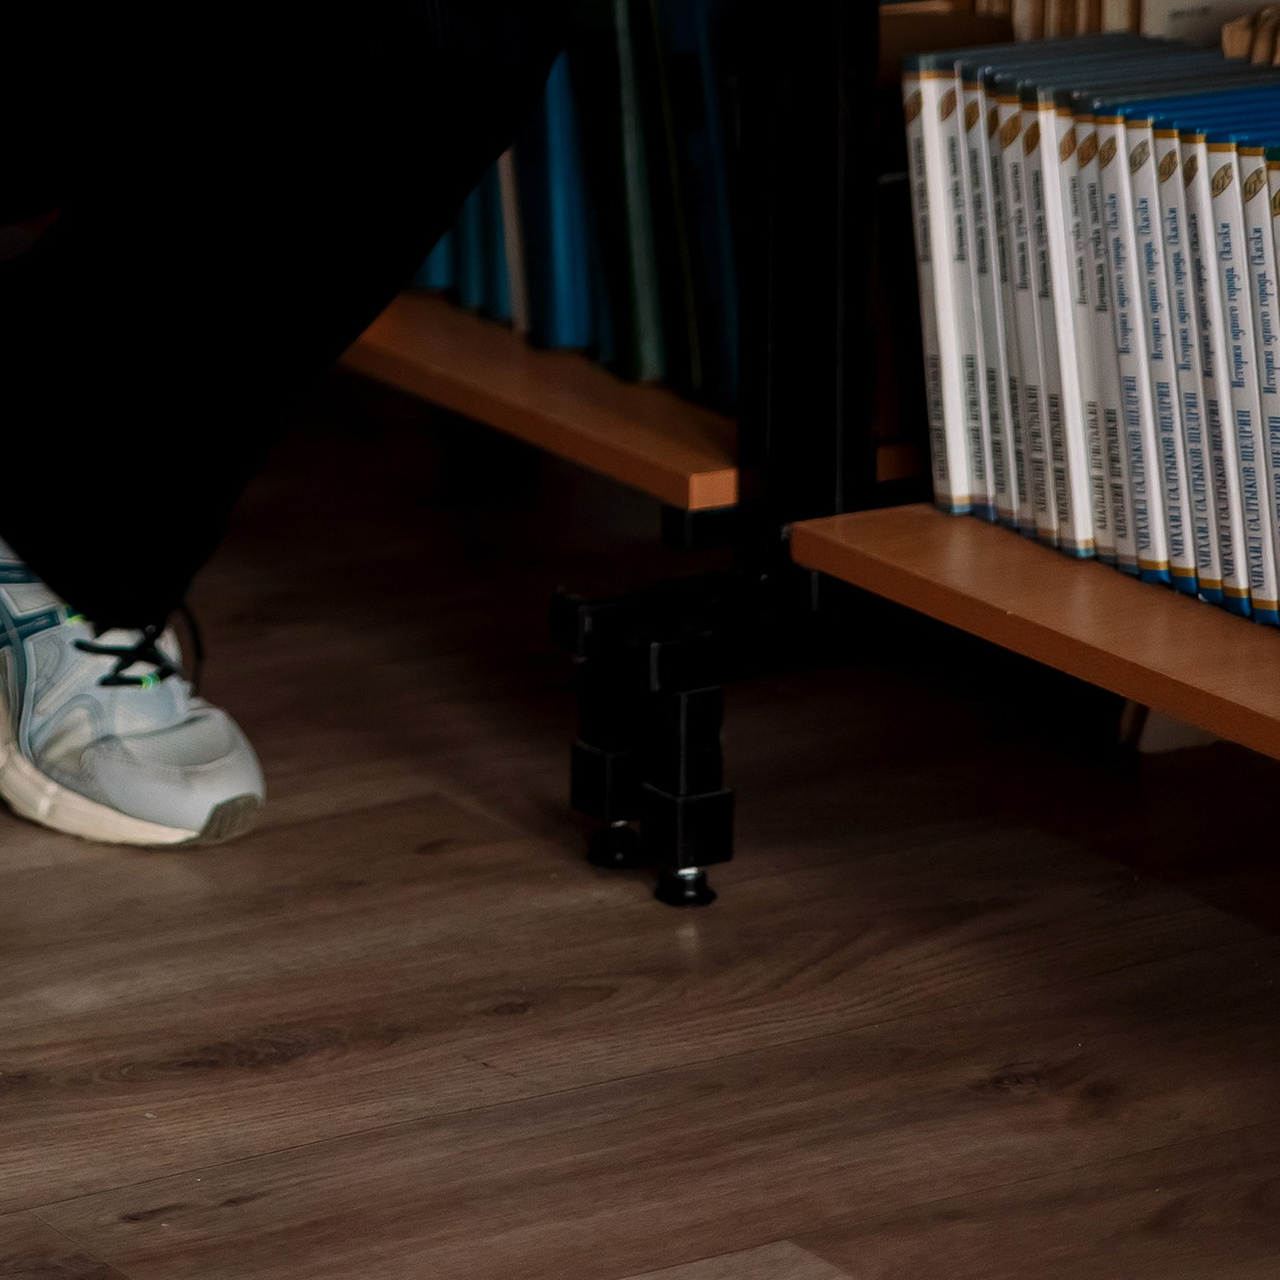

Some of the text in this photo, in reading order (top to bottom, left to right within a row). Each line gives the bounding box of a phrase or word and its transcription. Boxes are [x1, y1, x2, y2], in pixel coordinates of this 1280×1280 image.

[1229, 306, 1246, 341] одного
[1261, 311, 1278, 346] одного
[1231, 345, 1248, 388] История
[1263, 351, 1280, 394] История
[1135, 498, 1150, 551] МИХАИЛ
[1169, 505, 1184, 557] МИХАИЛ
[1195, 516, 1211, 569] МИХАИЛ
[1249, 535, 1265, 590] МИХАИЛ
